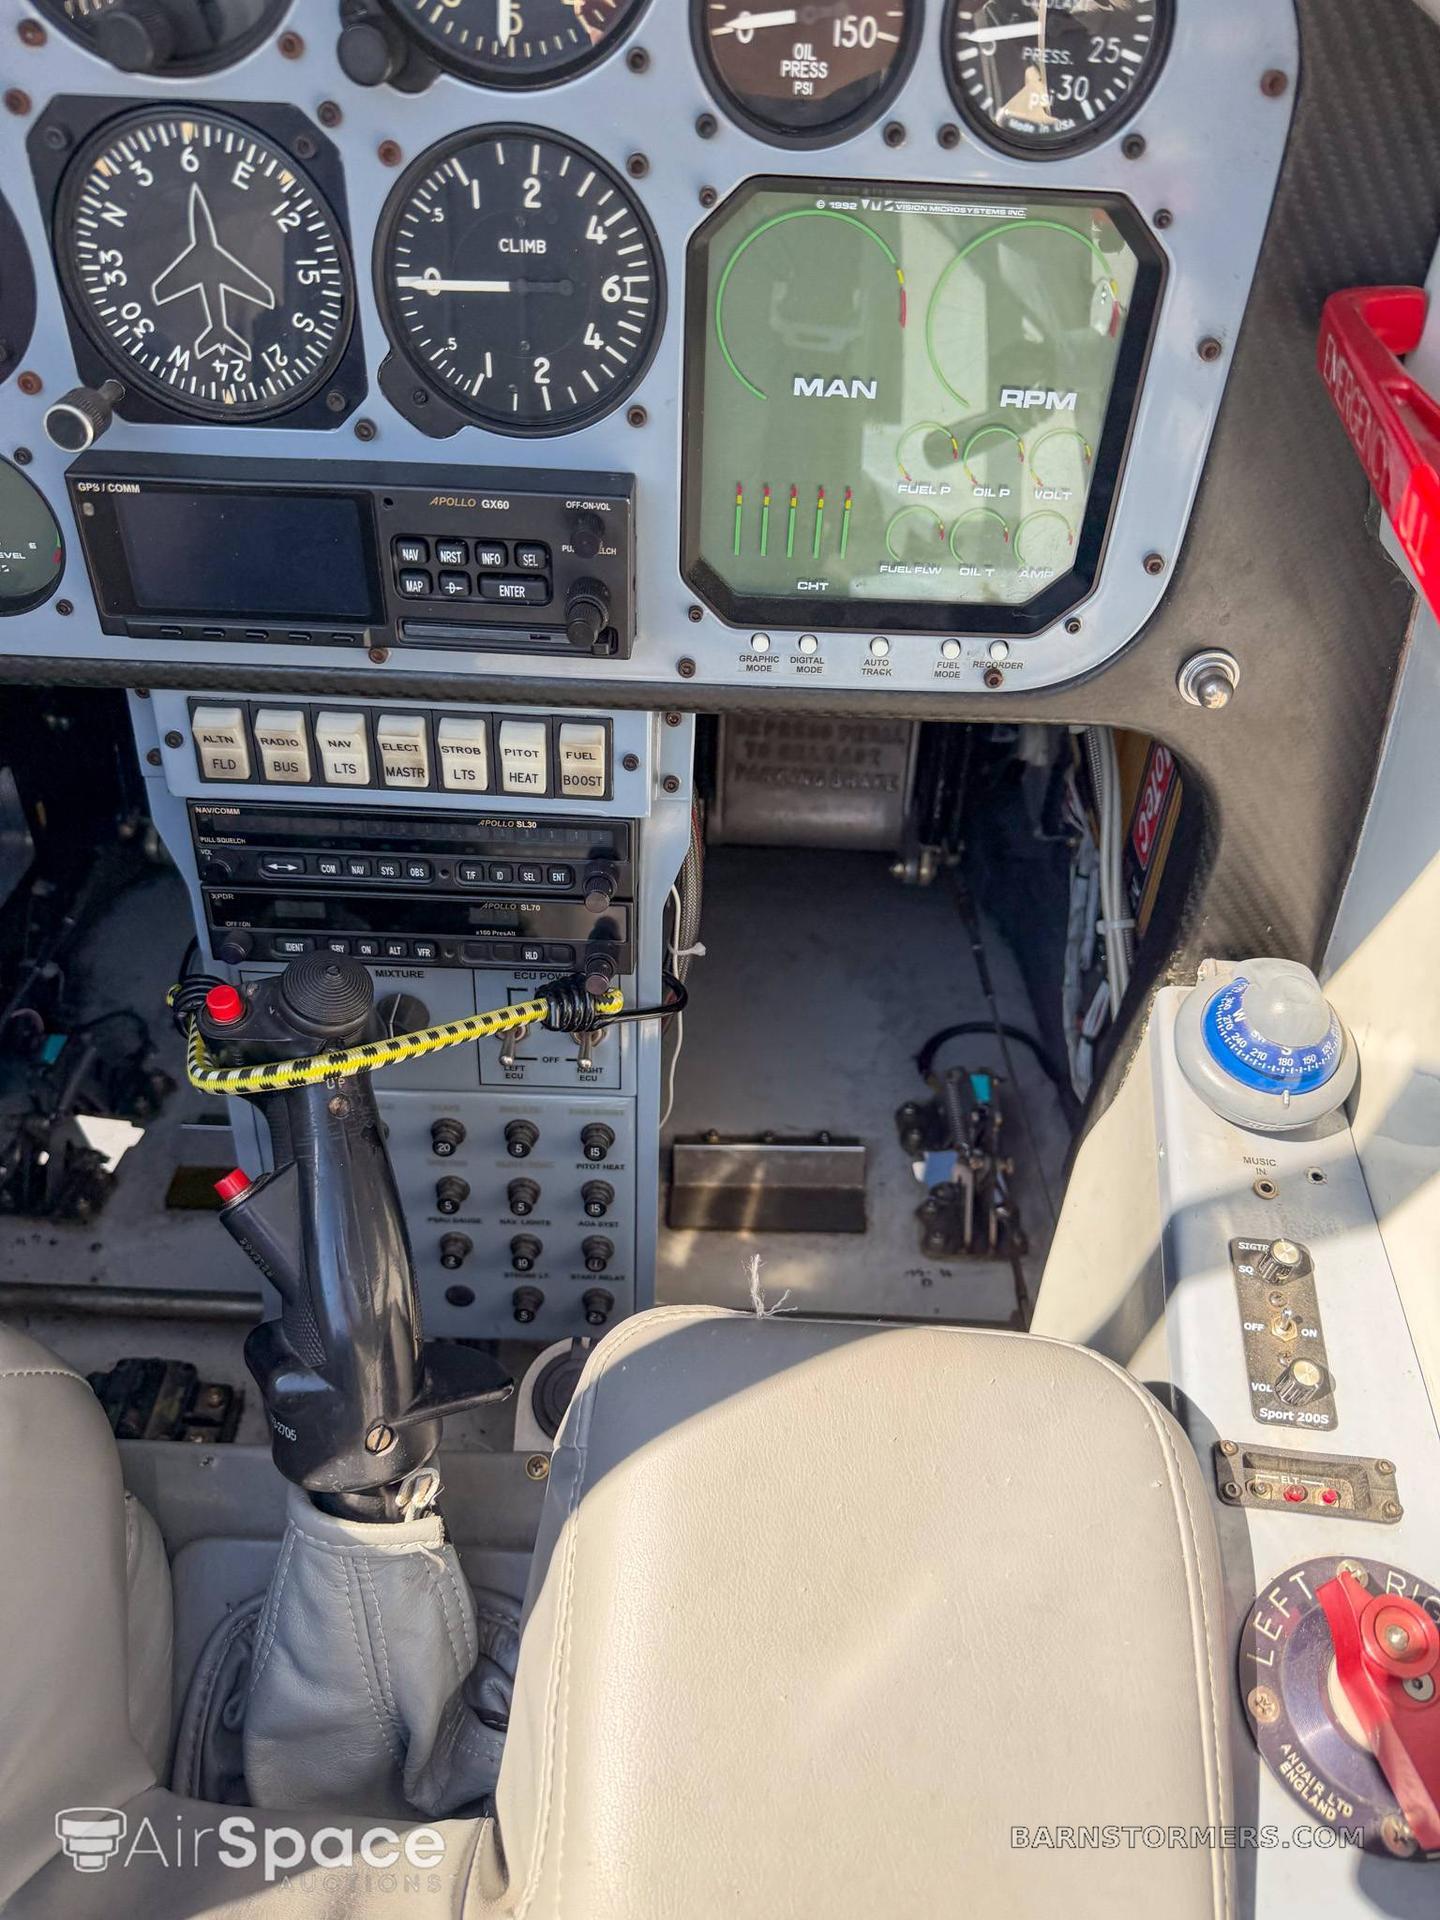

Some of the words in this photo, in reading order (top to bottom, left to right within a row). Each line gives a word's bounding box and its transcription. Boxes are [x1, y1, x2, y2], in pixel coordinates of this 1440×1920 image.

[833, 15, 878, 49] 150
[793, 43, 817, 61] OIL
[1087, 36, 1121, 64] 25
[780, 61, 829, 79] PRESS
[793, 82, 814, 96] PSI
[1057, 74, 1089, 101] 30
[1055, 119, 1076, 132] USA
[180, 146, 200, 173] 6
[129, 160, 154, 188] 3
[231, 163, 256, 191] E
[472, 178, 481, 210] 1
[522, 176, 542, 209] 2
[828, 201, 857, 211] 1992
[896, 202, 927, 213] VISION
[929, 205, 1007, 216] MICROSYSTEMS
[1007, 209, 1027, 217] INC.
[101, 201, 128, 228] N
[270, 200, 302, 234] 12
[584, 215, 608, 244] 4
[498, 238, 547, 255] CLIMB
[99, 248, 128, 287] 33
[295, 259, 321, 285] 15
[601, 275, 622, 303] 6
[120, 301, 155, 339] 30
[291, 311, 316, 333] S
[583, 322, 604, 350] 4
[167, 345, 191, 372] W
[260, 343, 289, 374] 21
[211, 359, 247, 384] 24
[533, 357, 551, 385] 2
[792, 377, 878, 400] MAN
[999, 388, 1079, 411] RPM
[77, 481, 100, 493] GPS
[107, 482, 141, 494] COMM
[897, 484, 938, 497] FUEL
[939, 485, 951, 497] P
[973, 486, 997, 498] OIL
[999, 487, 1011, 499] P
[1033, 488, 1073, 501] VOLT
[430, 496, 477, 508] APOLLO
[481, 499, 510, 511] GX60
[565, 500, 612, 512] OFF-ON-VOL
[402, 548, 419, 562] NAV
[440, 551, 462, 564] NRST
[481, 553, 501, 566] INFO
[523, 555, 539, 567] SEL
[879, 564, 914, 575] FUEL
[914, 565, 943, 576] FLW
[959, 565, 981, 577] OIL
[982, 566, 996, 577] T
[1018, 568, 1055, 580] AMP
[405, 580, 424, 593] MAP
[499, 585, 526, 598] ENTER
[796, 580, 830, 592] CHT
[738, 654, 780, 665] GRAPHIC
[789, 655, 825, 666] DIGITAL
[863, 658, 890, 668] AUTO
[936, 660, 961, 670] FUEL
[972, 659, 1025, 671] RECORDER
[745, 664, 773, 673] MODE
[796, 664, 824, 674] MODE
[861, 666, 893, 677] TRACK
[933, 669, 961, 679] MODE
[202, 734, 234, 745] ALTN
[260, 737, 300, 747] RADIO
[328, 740, 352, 749] NAV
[381, 742, 420, 753] ELECT
[440, 745, 482, 756] STROB
[503, 748, 540, 758] PITOT
[565, 751, 597, 761] FUEL
[212, 758, 237, 771] FLD
[273, 761, 299, 773] BUS
[333, 763, 357, 775] LTS
[385, 766, 425, 779] MASTR
[453, 769, 476, 781] LTS
[509, 772, 539, 784] HEAT
[563, 774, 603, 787] BOOST
[195, 806, 241, 816] NAV/COMM
[478, 819, 515, 829] APOLLO
[516, 820, 537, 829] SL30
[320, 863, 337, 874] COM
[351, 864, 365, 875] NAV
[381, 866, 395, 876] SYS
[409, 867, 424, 878] OBS
[496, 871, 504, 881] ID
[523, 872, 536, 882] SEL
[552, 872, 566, 882] ENT
[480, 902, 517, 911] APOLLO
[520, 903, 541, 911] SL70
[285, 942, 304, 952] IDENT
[361, 945, 372, 955] ON
[389, 945, 402, 955] ALT
[417, 948, 431, 958] VFR
[525, 950, 538, 960] HLD
[375, 969, 425, 979] MIXTURE
[513, 971, 537, 980] ECU
[1233, 1007, 1247, 1023] W
[1222, 1014, 1234, 1031] 270
[1230, 1031, 1248, 1049] 240
[542, 1056, 560, 1064] OFF
[1250, 1047, 1268, 1061] 210
[1302, 1054, 1317, 1065] 150
[1278, 1057, 1294, 1067] 180
[505, 1072, 524, 1080] ECU
[579, 1074, 598, 1082] ECU
[438, 1143, 451, 1152] 20
[515, 1144, 523, 1153] 5
[590, 1147, 600, 1156] 15
[1242, 1155, 1277, 1167] MUSIC
[1255, 1167, 1266, 1176] IN
[1238, 1265, 1255, 1275] SQ
[1243, 1323, 1265, 1332] OFF
[1301, 1328, 1318, 1338] ON
[1251, 1382, 1273, 1393] VOL
[1259, 1407, 1295, 1422] Sport
[1297, 1411, 1330, 1425] 200S
[1280, 1475, 1300, 1485] ELT
[1246, 1570, 1315, 1667] LEFT
[1280, 1742, 1325, 1796] ANDAIR
[1327, 1793, 1354, 1819] LTD
[1278, 1761, 1339, 1823] ENGLAND
